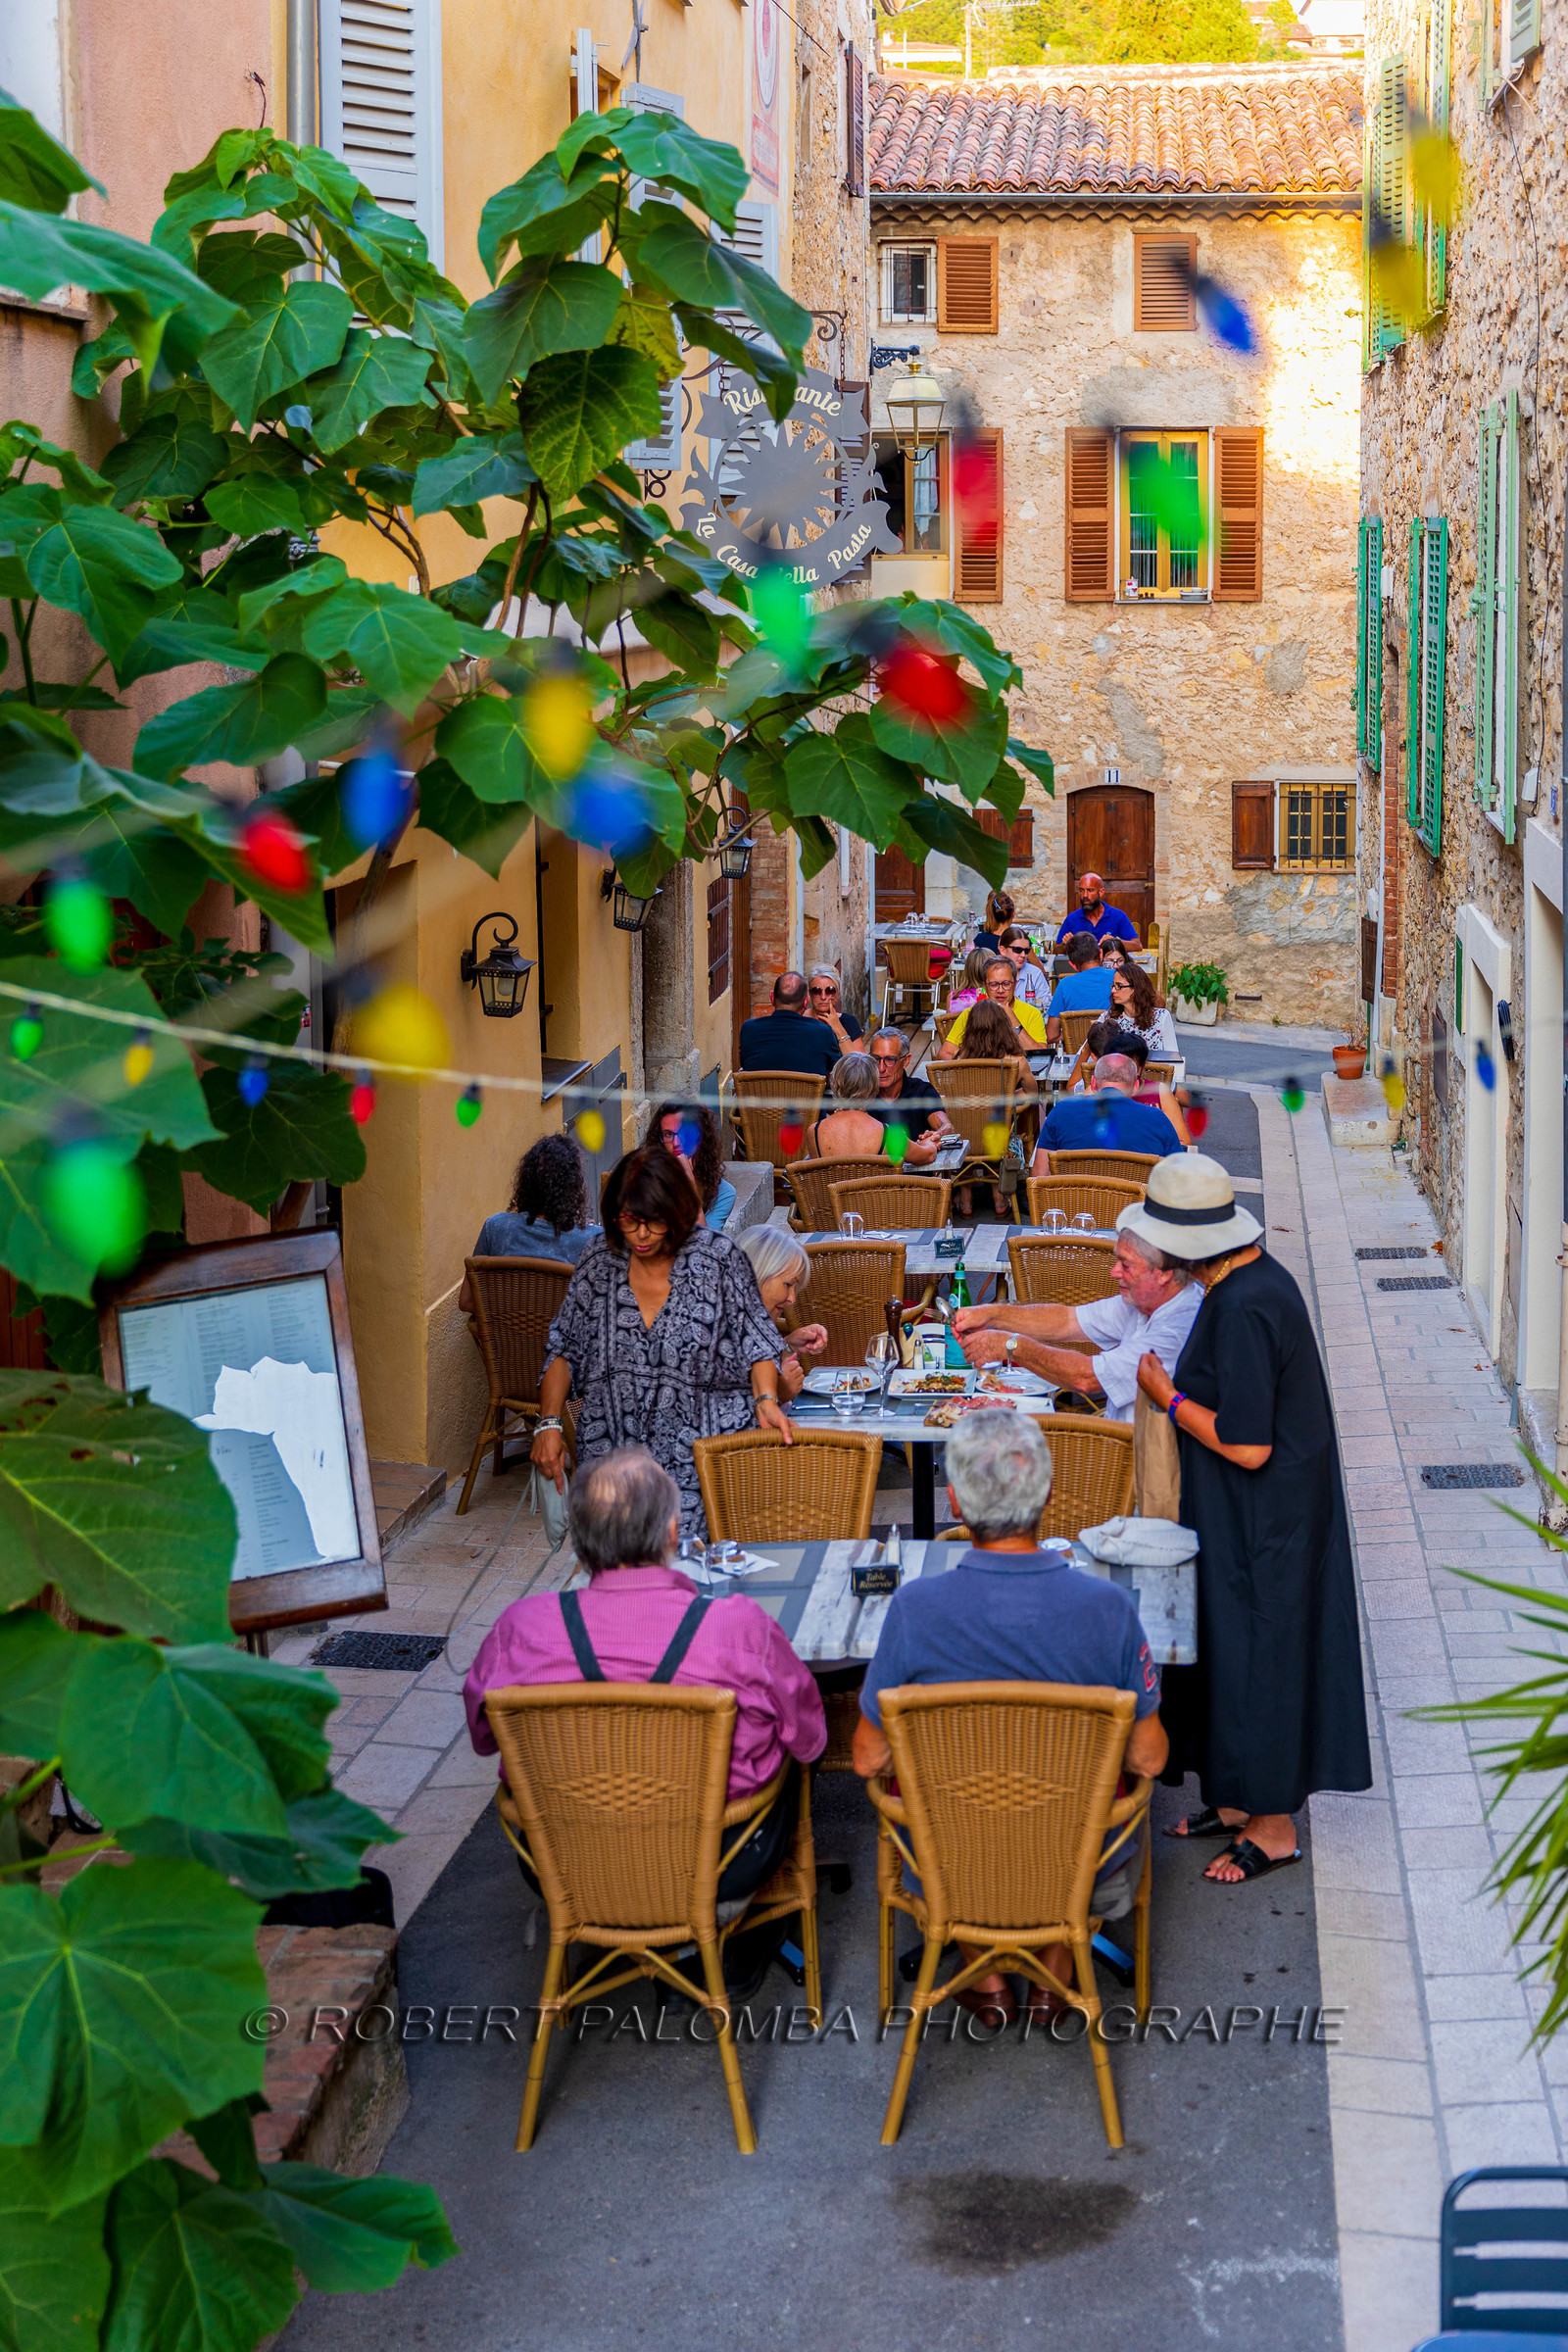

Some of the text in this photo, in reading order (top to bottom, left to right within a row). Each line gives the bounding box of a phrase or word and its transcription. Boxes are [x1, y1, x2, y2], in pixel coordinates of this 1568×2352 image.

[723, 386, 842, 416] Risante
[716, 545, 759, 579] Casa
[827, 523, 872, 570] Pasta
[1106, 770, 1119, 783] 11
[866, 1572, 886, 1582] Table
[1139, 1642, 1157, 1692] 2
